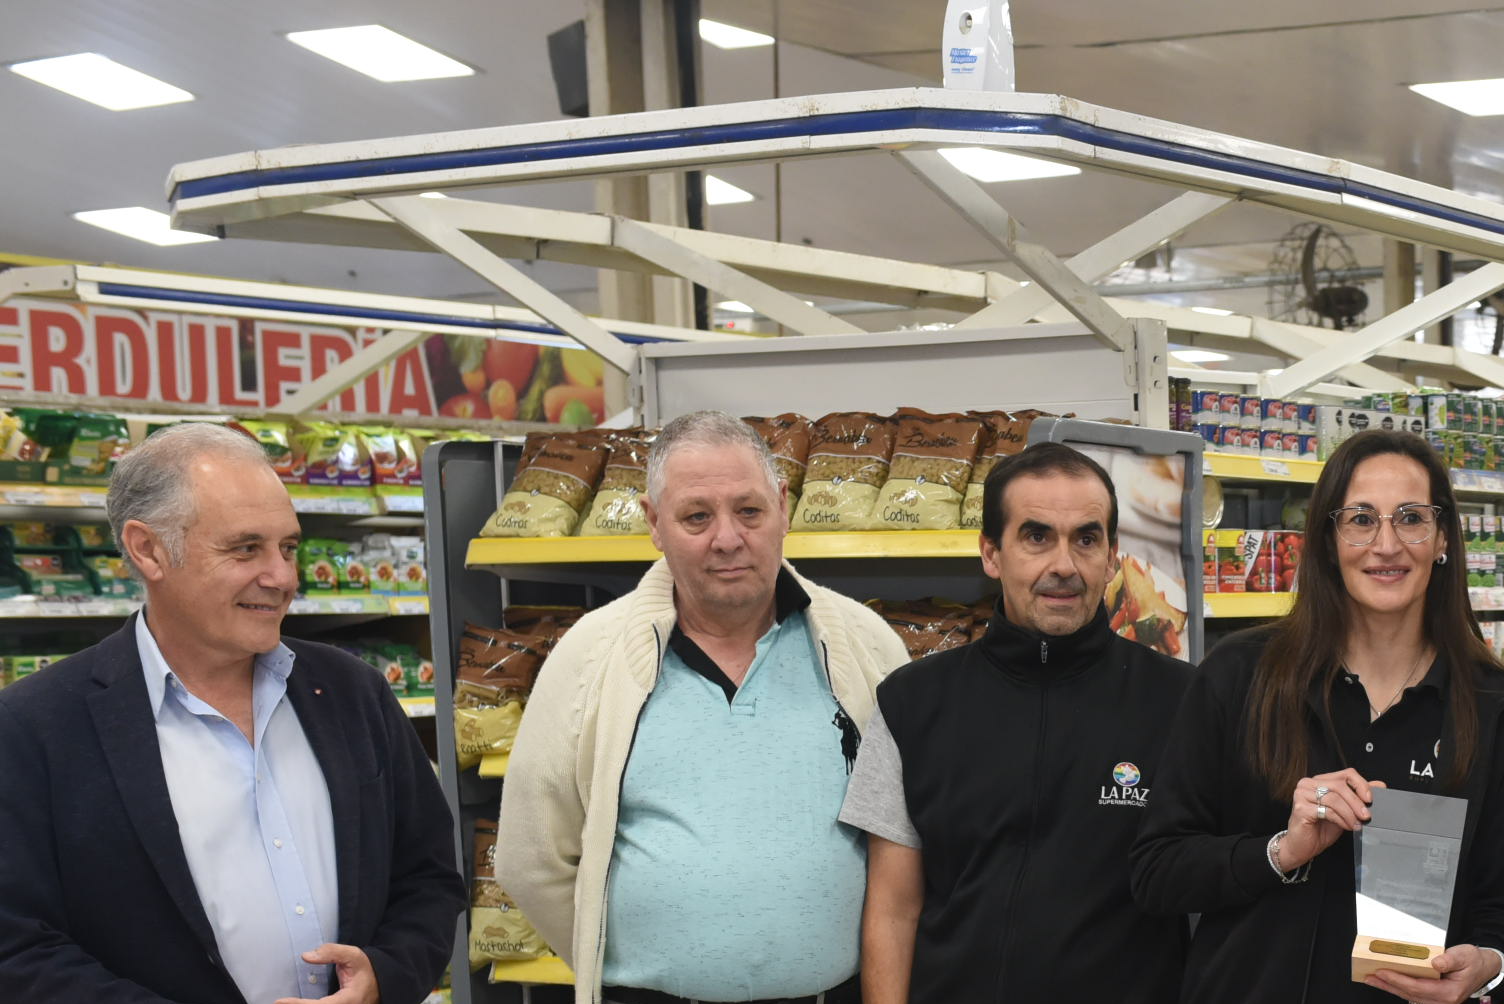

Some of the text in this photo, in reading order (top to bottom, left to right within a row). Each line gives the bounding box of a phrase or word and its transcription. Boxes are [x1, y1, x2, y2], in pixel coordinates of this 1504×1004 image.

[803, 509, 841, 524] Coditos
[884, 506, 920, 524] Coditos
[1410, 760, 1434, 778] LA
[1101, 786, 1150, 802] LA PAZ
